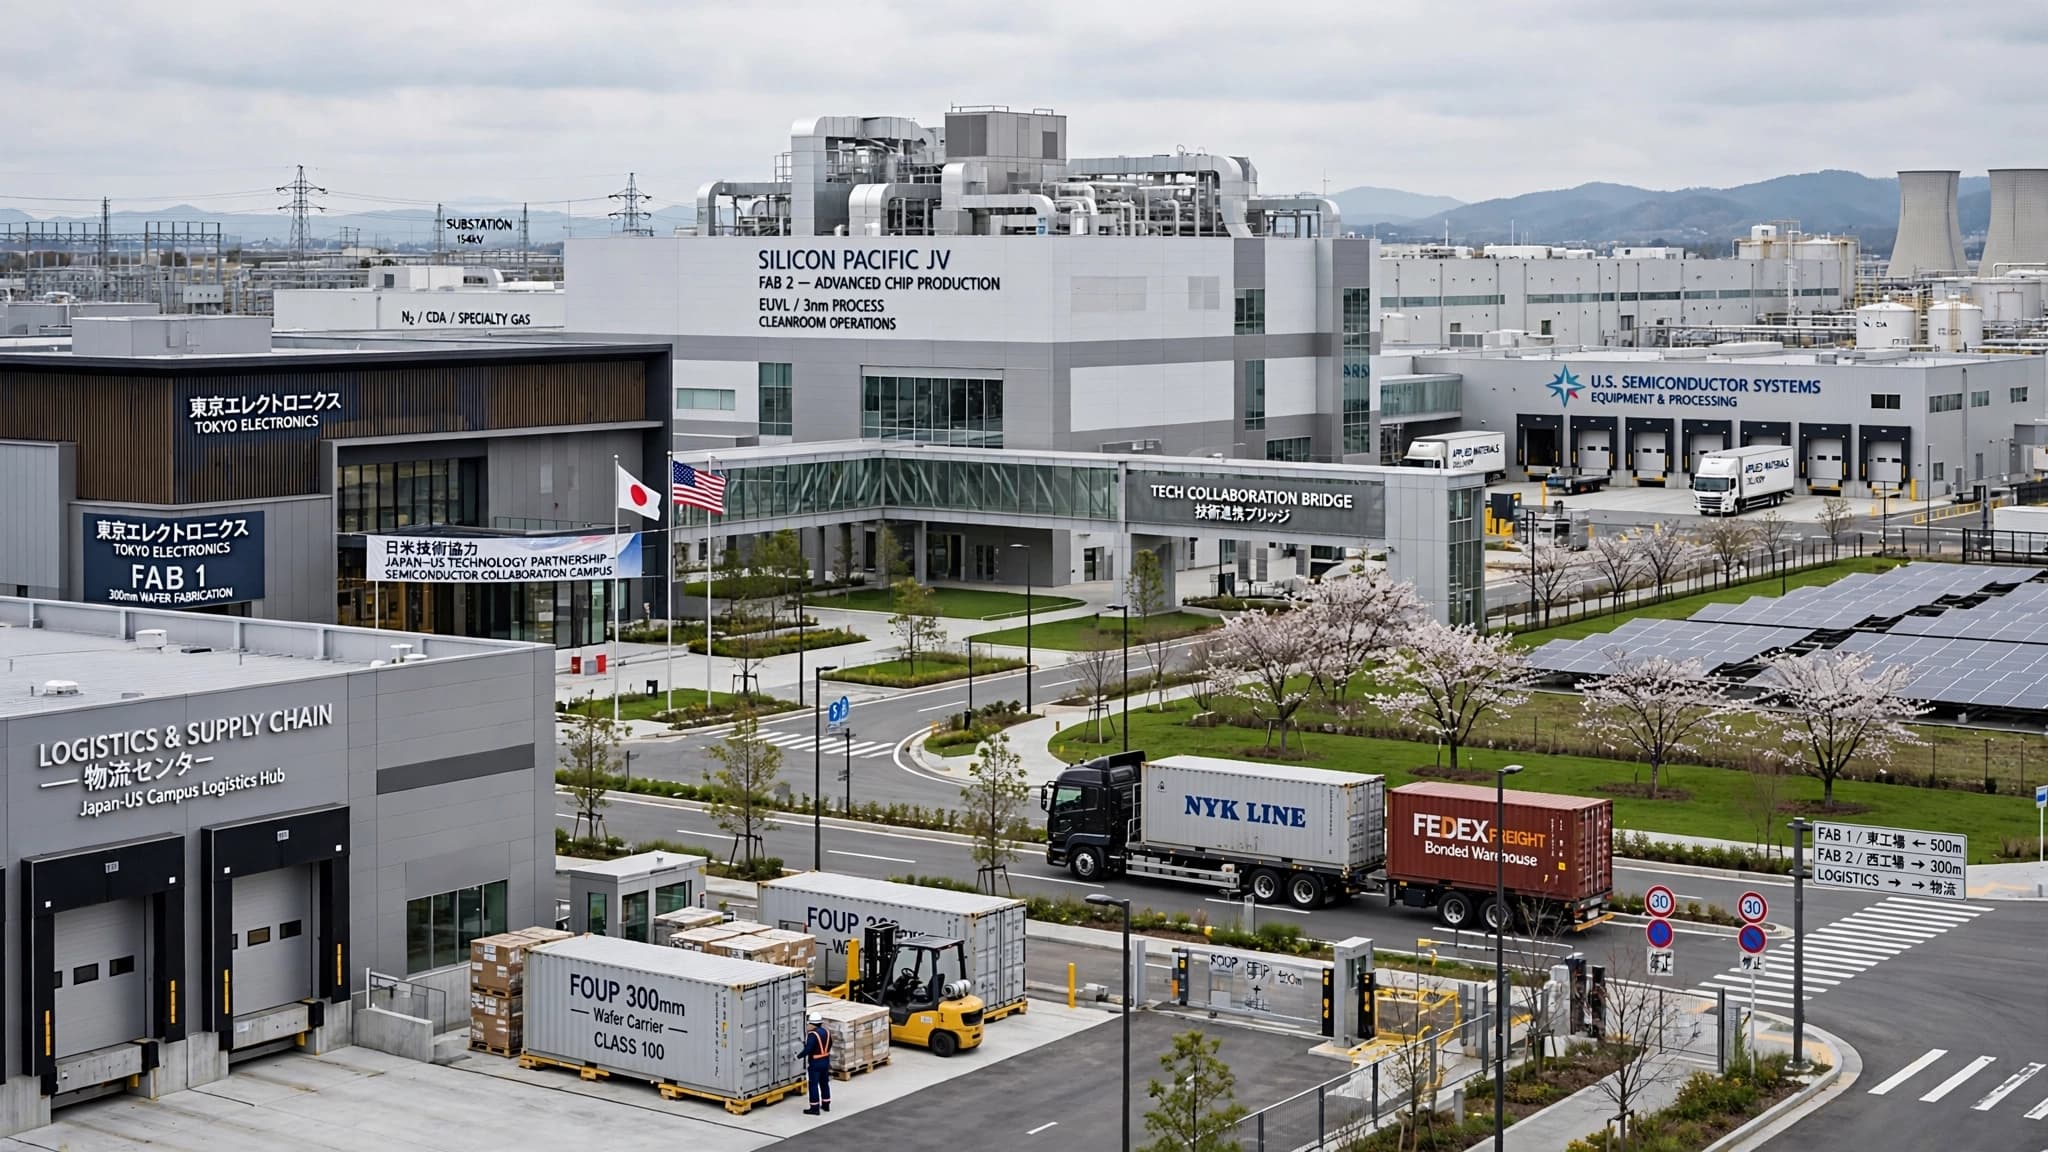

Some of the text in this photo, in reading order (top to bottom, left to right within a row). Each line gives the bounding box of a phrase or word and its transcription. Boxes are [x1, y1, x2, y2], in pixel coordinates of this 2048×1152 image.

[446, 218, 512, 230] SUBSTATION
[758, 250, 951, 270] SILICON PACIFIC JV
[759, 276, 782, 289] FAB
[786, 276, 794, 289] 2
[814, 276, 881, 290] ADVANCED
[884, 277, 914, 290] CHIP
[918, 277, 1000, 290] PRODUCTION
[759, 298, 790, 312] EUVL
[804, 299, 828, 312] 3nm
[832, 299, 884, 312] PROCESS
[426, 312, 446, 323] CDA
[458, 312, 507, 325] SPECIALTY
[511, 314, 530, 325] GAS
[759, 316, 896, 330] CLEANROOM OPERATIONS
[1591, 375, 1821, 394] U.S. SEMICONDUCTOR SYSTEMS
[189, 391, 342, 419] 東京エレクトロニクス
[1591, 392, 1737, 407] EQUIPMENT & PROCESSING
[194, 415, 319, 434] TOKYO ELECTRONICS
[1150, 485, 1353, 509] TECH COLLABORATION BRIDGE
[96, 519, 249, 543] 東京エレクトロニクス
[113, 542, 230, 558] TOKYO ELECTRONICS
[386, 540, 478, 557] 日米技術協力
[447, 556, 527, 568] TECHNOLOGY
[131, 564, 205, 590] FAB 1
[385, 566, 612, 580] SEMICONDUCTOR COLLABORATION CAMPUS
[109, 587, 233, 603] 300mm WAFER FABRICATION
[39, 704, 333, 767] LOGISTICS & SUPPLY CHAIN
[84, 752, 214, 791] 物流センター
[80, 768, 285, 818] Japan-US Campus Logistics Hub
[1185, 795, 1239, 821] NYK
[1247, 802, 1306, 828] LINE
[1413, 813, 1489, 844] FEDEX
[1425, 840, 1468, 858] Bonded
[1818, 827, 1841, 841] FAB
[1847, 830, 1851, 842] 1
[1931, 839, 1961, 854] 500m
[1818, 848, 1841, 862] FAB
[1845, 851, 1853, 864] 2
[1931, 860, 1961, 875] 300m
[1818, 869, 1879, 886] LOGISTICS
[1652, 894, 1668, 909] 30
[1744, 900, 1760, 915] 30
[808, 906, 859, 934] FOUP
[570, 973, 685, 1017] FOUP 300mm
[593, 1008, 663, 1034] Wafer Carrier
[594, 1032, 664, 1060] CLASS 100
